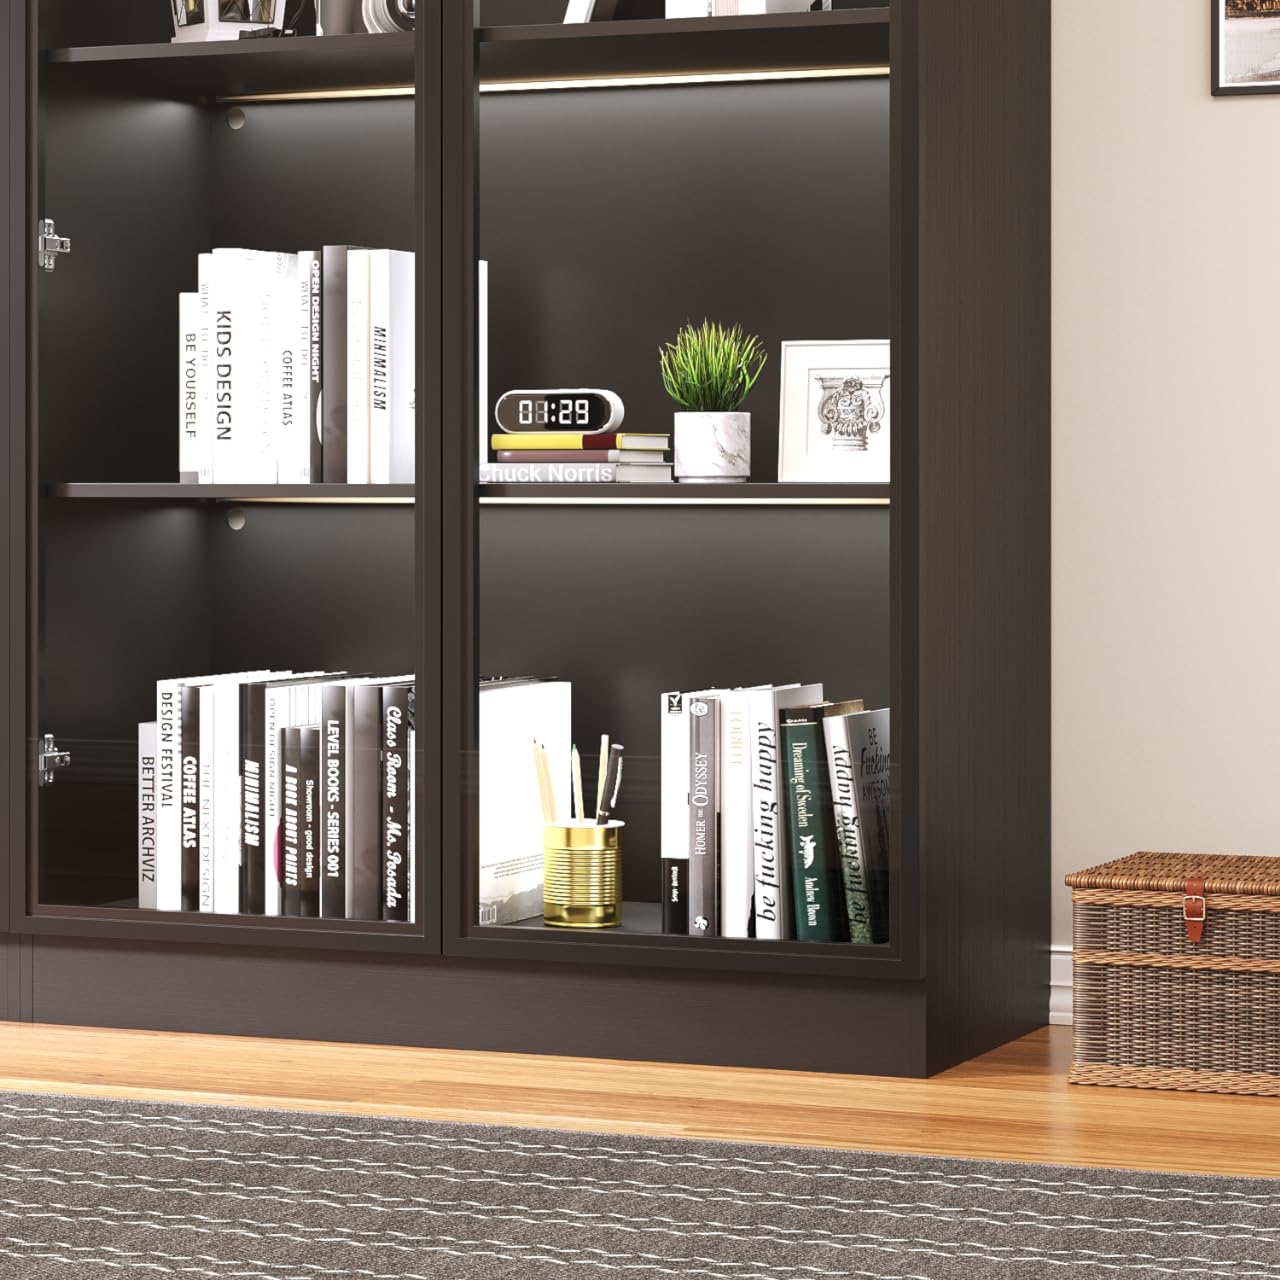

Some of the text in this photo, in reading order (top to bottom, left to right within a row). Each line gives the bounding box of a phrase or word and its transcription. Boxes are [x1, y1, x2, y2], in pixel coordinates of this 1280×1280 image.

[312, 260, 320, 383] OPEN DESIGN NIGHT
[186, 334, 196, 438] BE YOURSELF
[217, 311, 232, 440] KIDS DESIGN
[283, 350, 292, 426] COFFEE ATLAS
[519, 400, 588, 424] 01:29
[548, 464, 612, 482] Norris
[162, 692, 173, 808] DESIGN FESTIVAL
[387, 706, 401, 747] Class
[868, 728, 877, 745] BE
[387, 752, 401, 798] Room
[692, 752, 708, 806] ODYSSEY
[790, 743, 809, 784] Dreaming
[832, 745, 854, 807] happy
[861, 746, 889, 776] Fuckin
[183, 756, 197, 848] COFFEE ATLAS
[328, 720, 339, 878] LEVEL BOOKS SERIES 001
[795, 785, 811, 794] of
[797, 795, 813, 827] Sweden
[142, 757, 154, 882] BETTER ARCHVIZ
[304, 830, 313, 850] good
[695, 820, 706, 855] HOMER
[754, 722, 779, 922] be fucking happy
[305, 852, 313, 878] design
[804, 877, 820, 926] Andrew Brown
